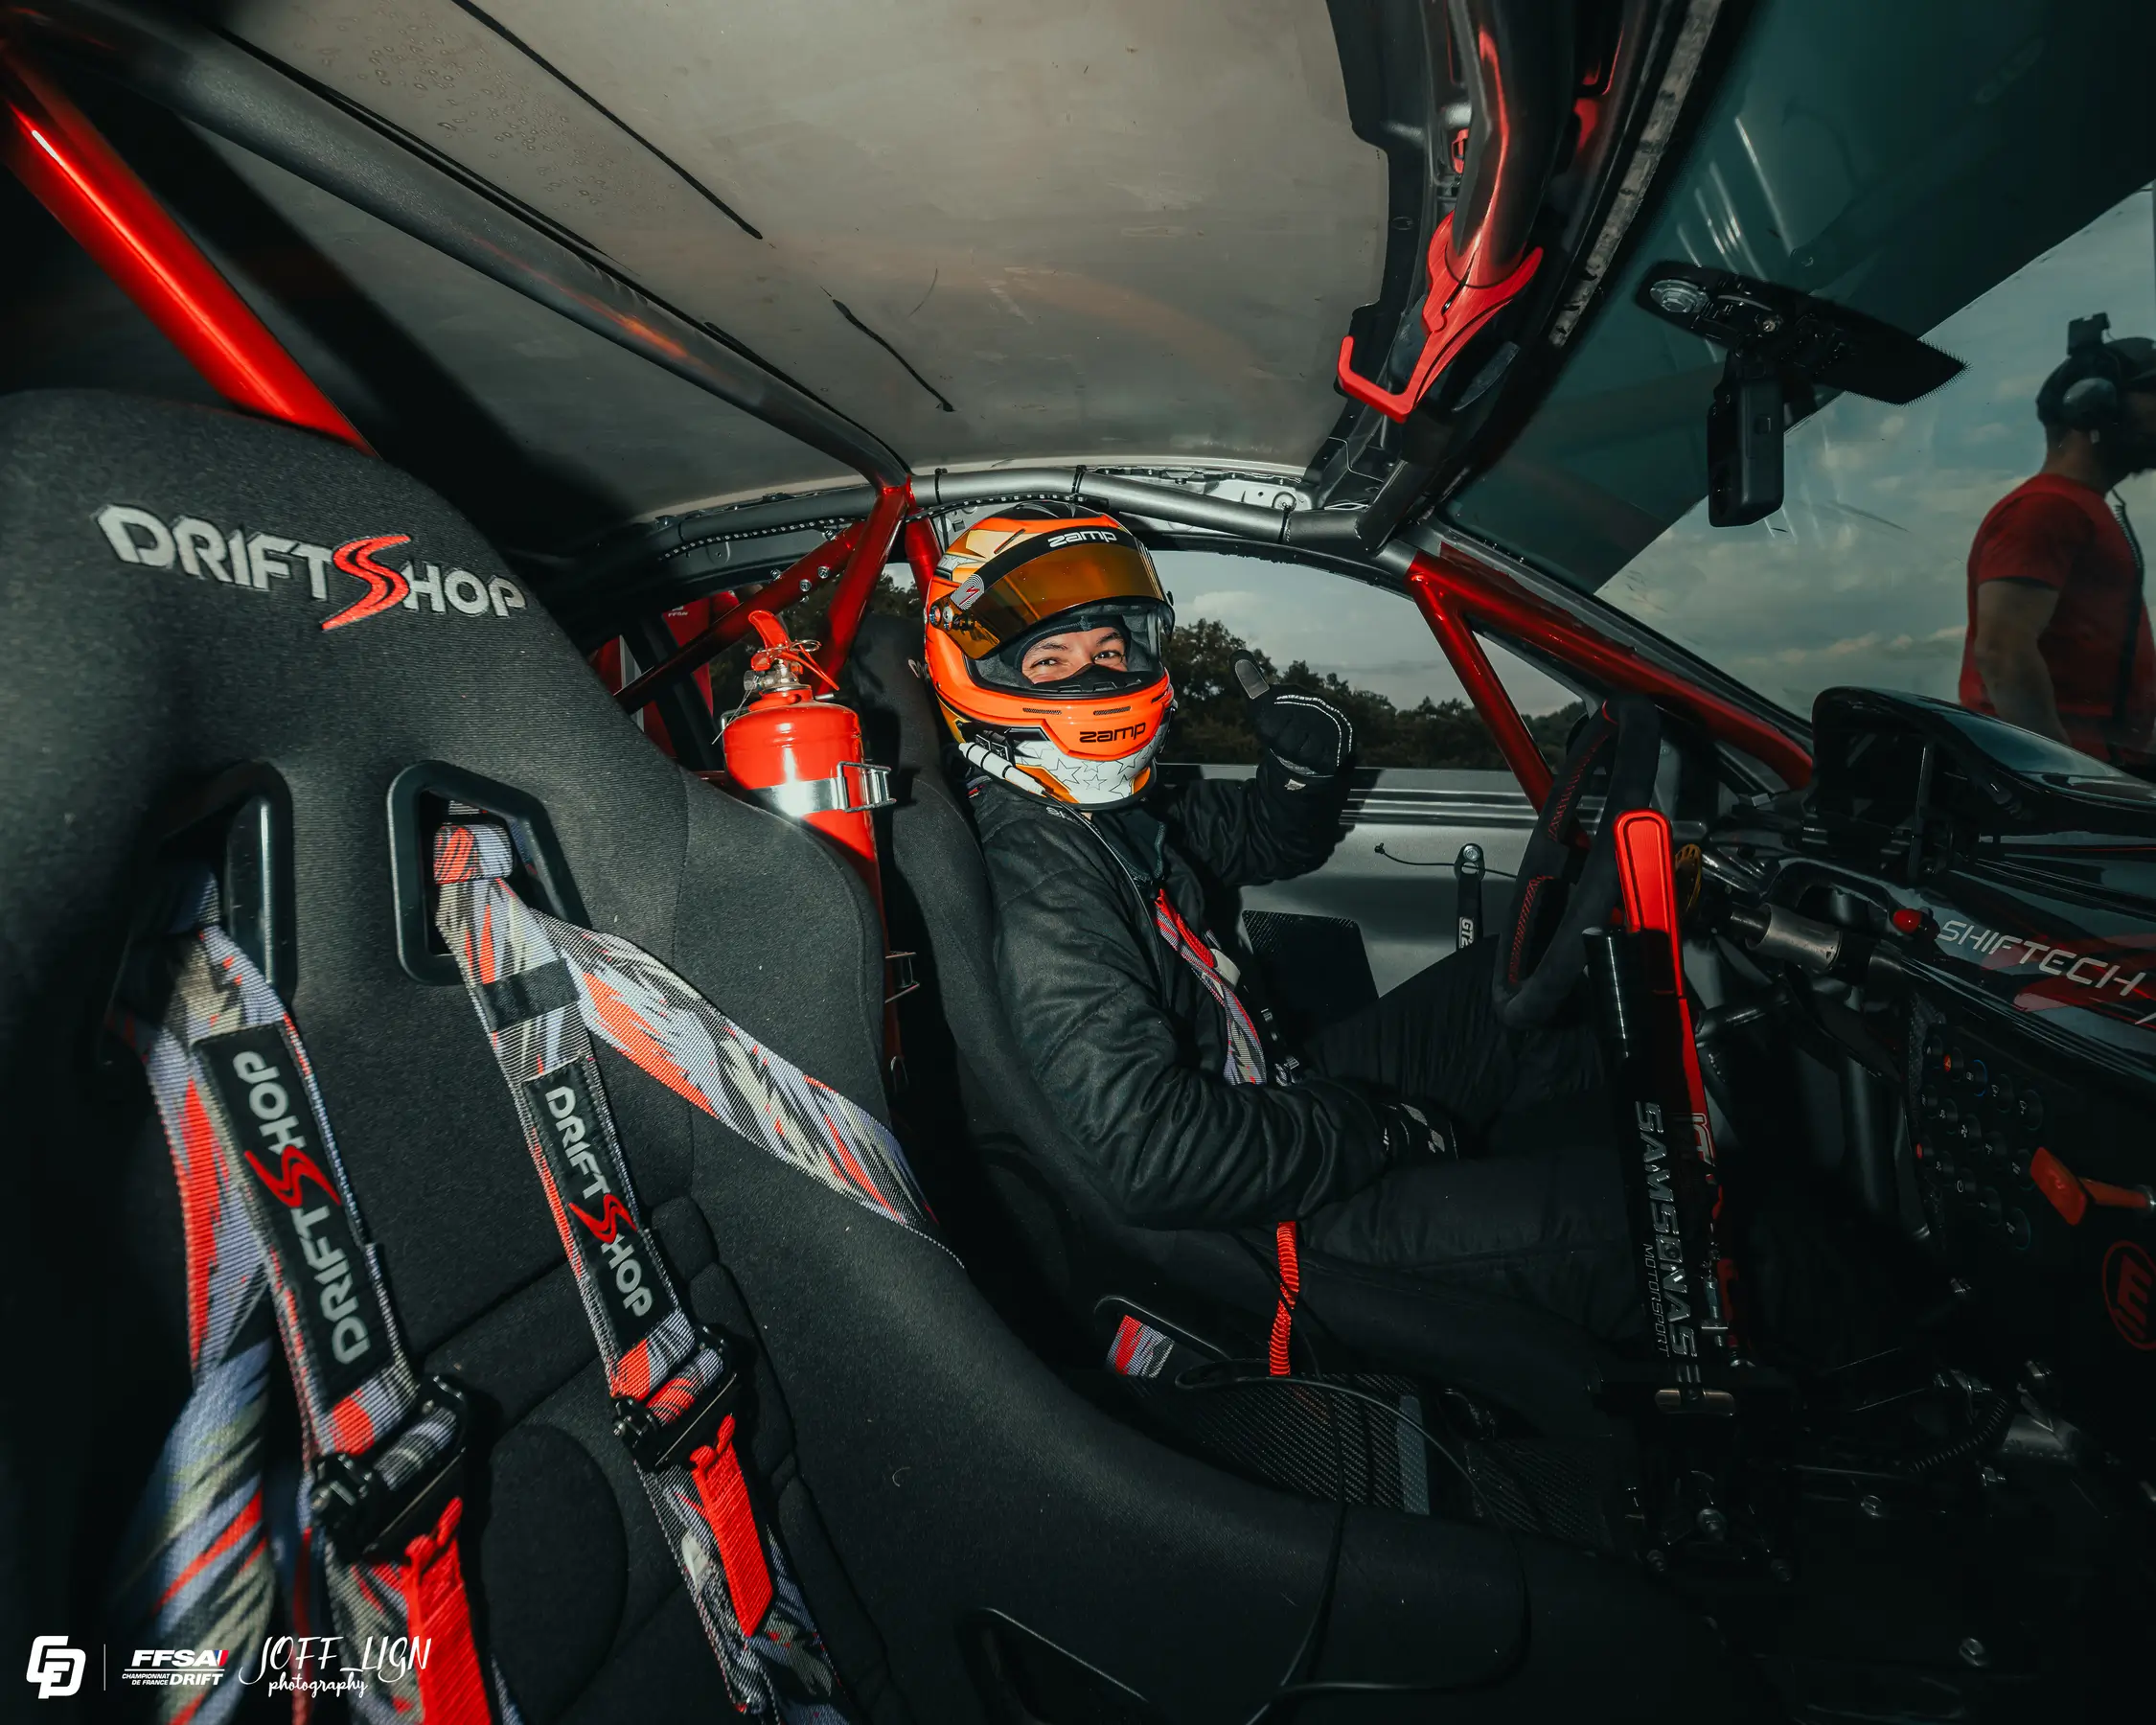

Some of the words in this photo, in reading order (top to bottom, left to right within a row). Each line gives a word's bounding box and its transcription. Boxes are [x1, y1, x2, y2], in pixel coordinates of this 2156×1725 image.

[1047, 530, 1117, 548] zamp
[1079, 722, 1146, 744] zamp
[1938, 920, 2145, 997] SHIFTECH
[1635, 1101, 1698, 1359] SAMSONAS
[1642, 1244, 1670, 1358] MOTORSPORT
